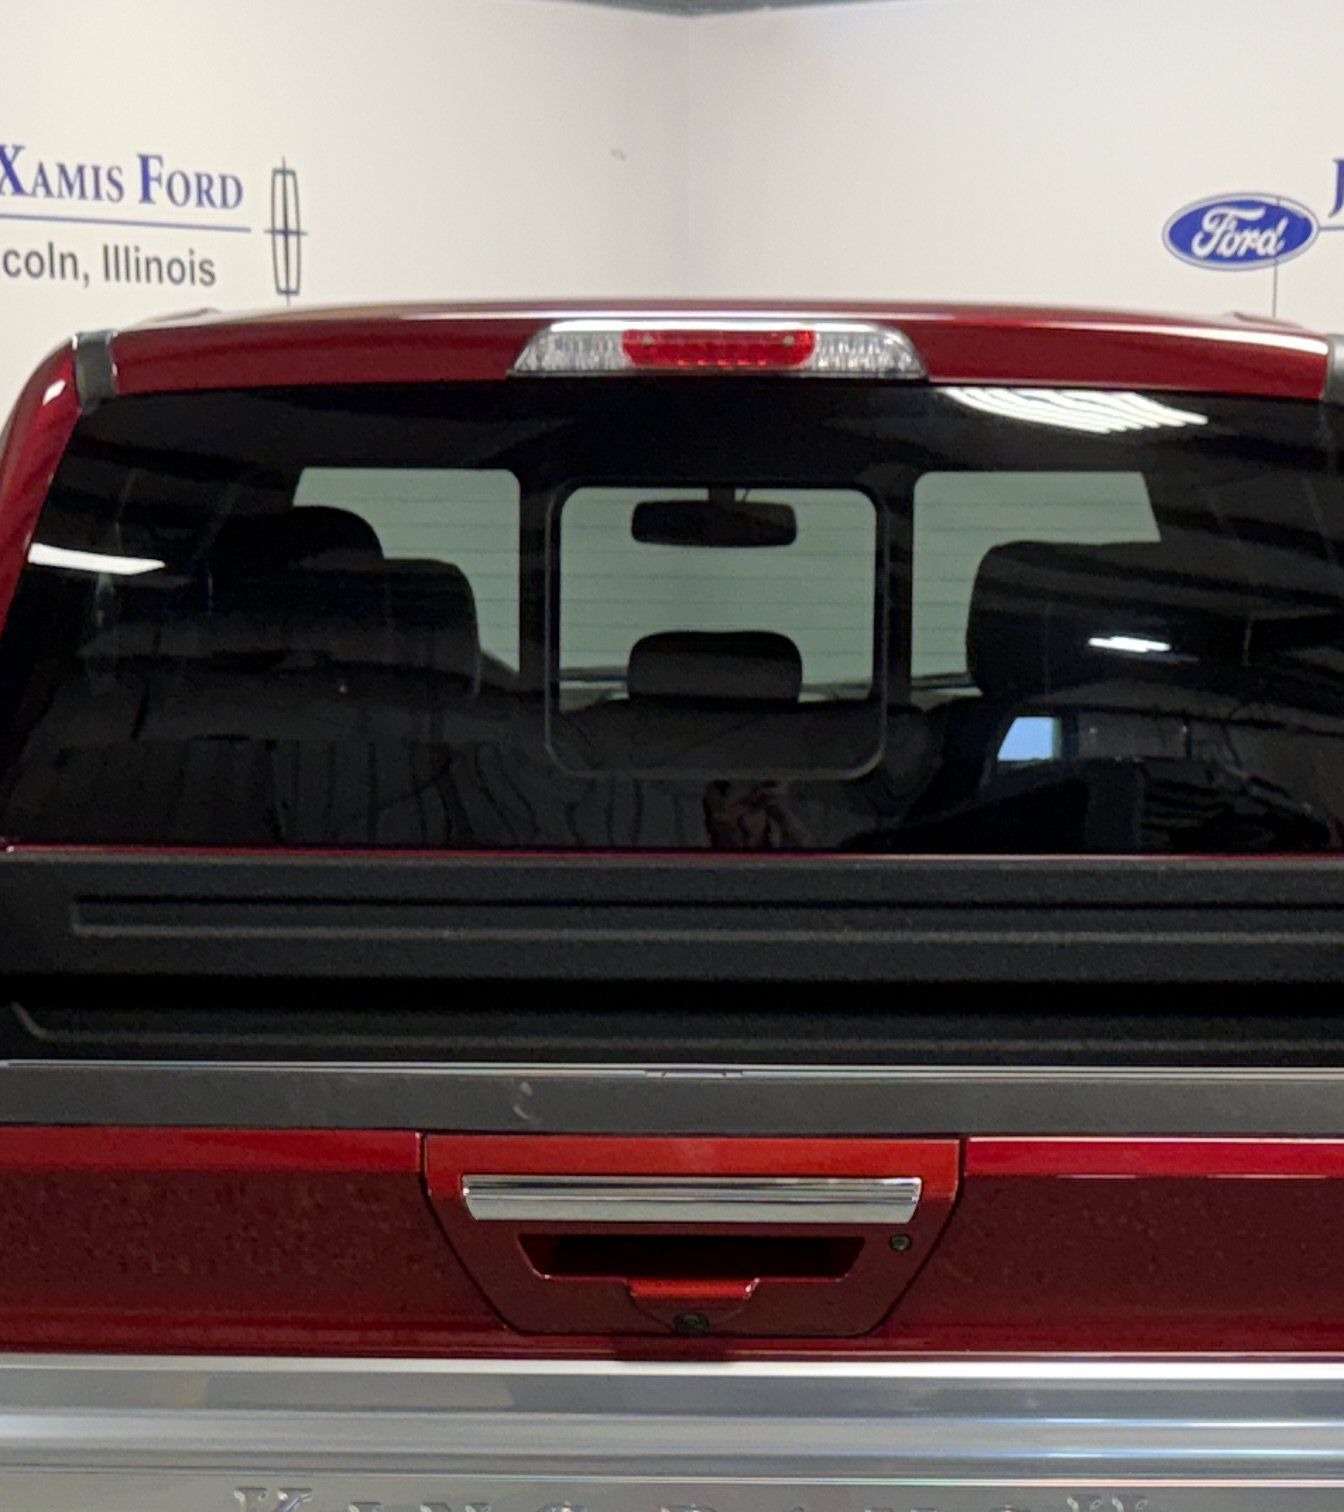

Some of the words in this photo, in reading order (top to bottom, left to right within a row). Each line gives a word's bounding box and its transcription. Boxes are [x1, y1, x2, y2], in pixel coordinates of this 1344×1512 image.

[136, 153, 244, 210] FORD
[1191, 206, 1286, 257] Ford
[102, 243, 216, 287] Illinois
